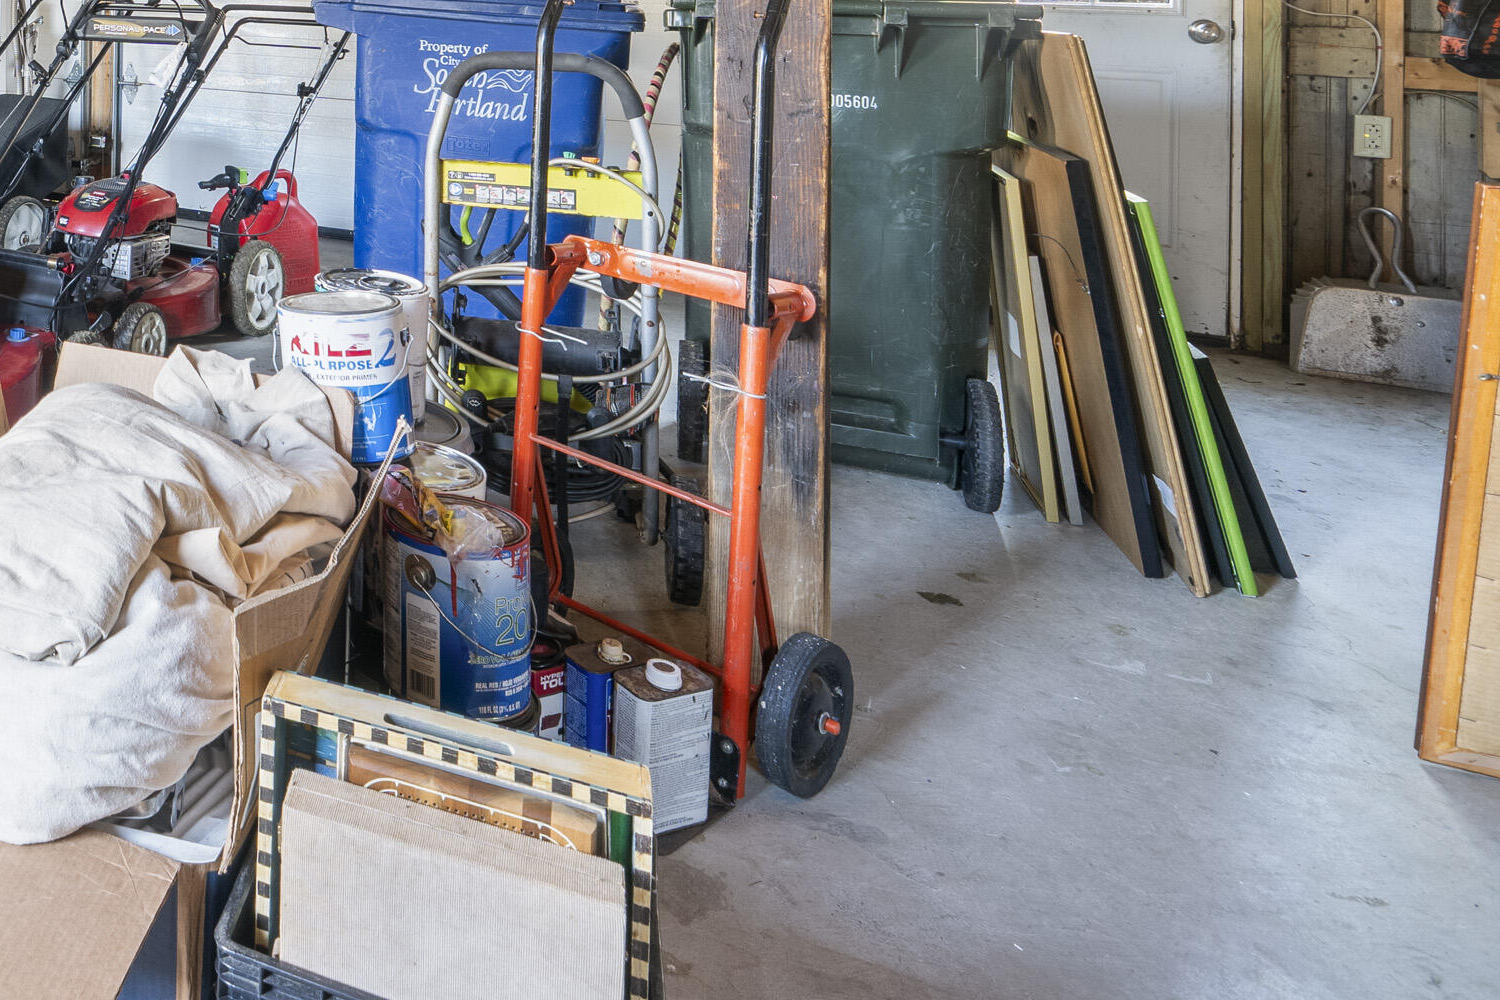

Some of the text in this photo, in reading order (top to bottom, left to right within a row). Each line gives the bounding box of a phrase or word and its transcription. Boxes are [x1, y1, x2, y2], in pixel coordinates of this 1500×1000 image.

[93, 23, 167, 34] PERSONAL PACE
[419, 39, 489, 57] Property of
[440, 55, 460, 68] City
[424, 87, 529, 122] Prtland
[375, 327, 397, 369] 2
